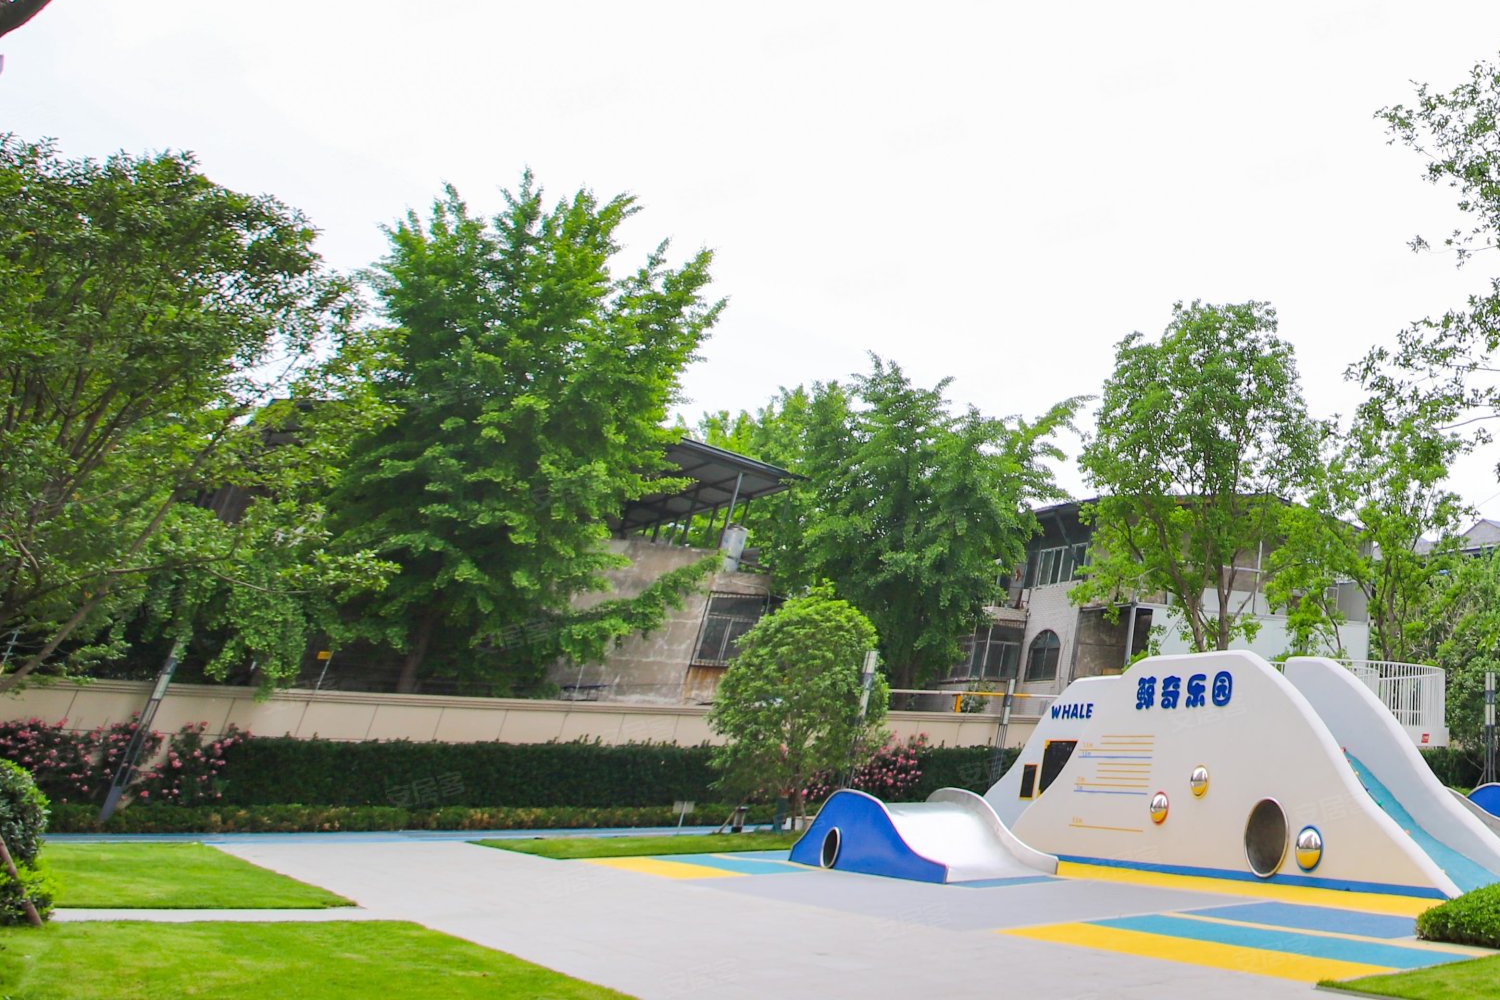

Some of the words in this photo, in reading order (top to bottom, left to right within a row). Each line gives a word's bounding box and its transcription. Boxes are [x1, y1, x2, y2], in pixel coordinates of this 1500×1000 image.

[1136, 670, 1234, 710] 鲸奇乐园
[1050, 703, 1094, 720] WHALE
